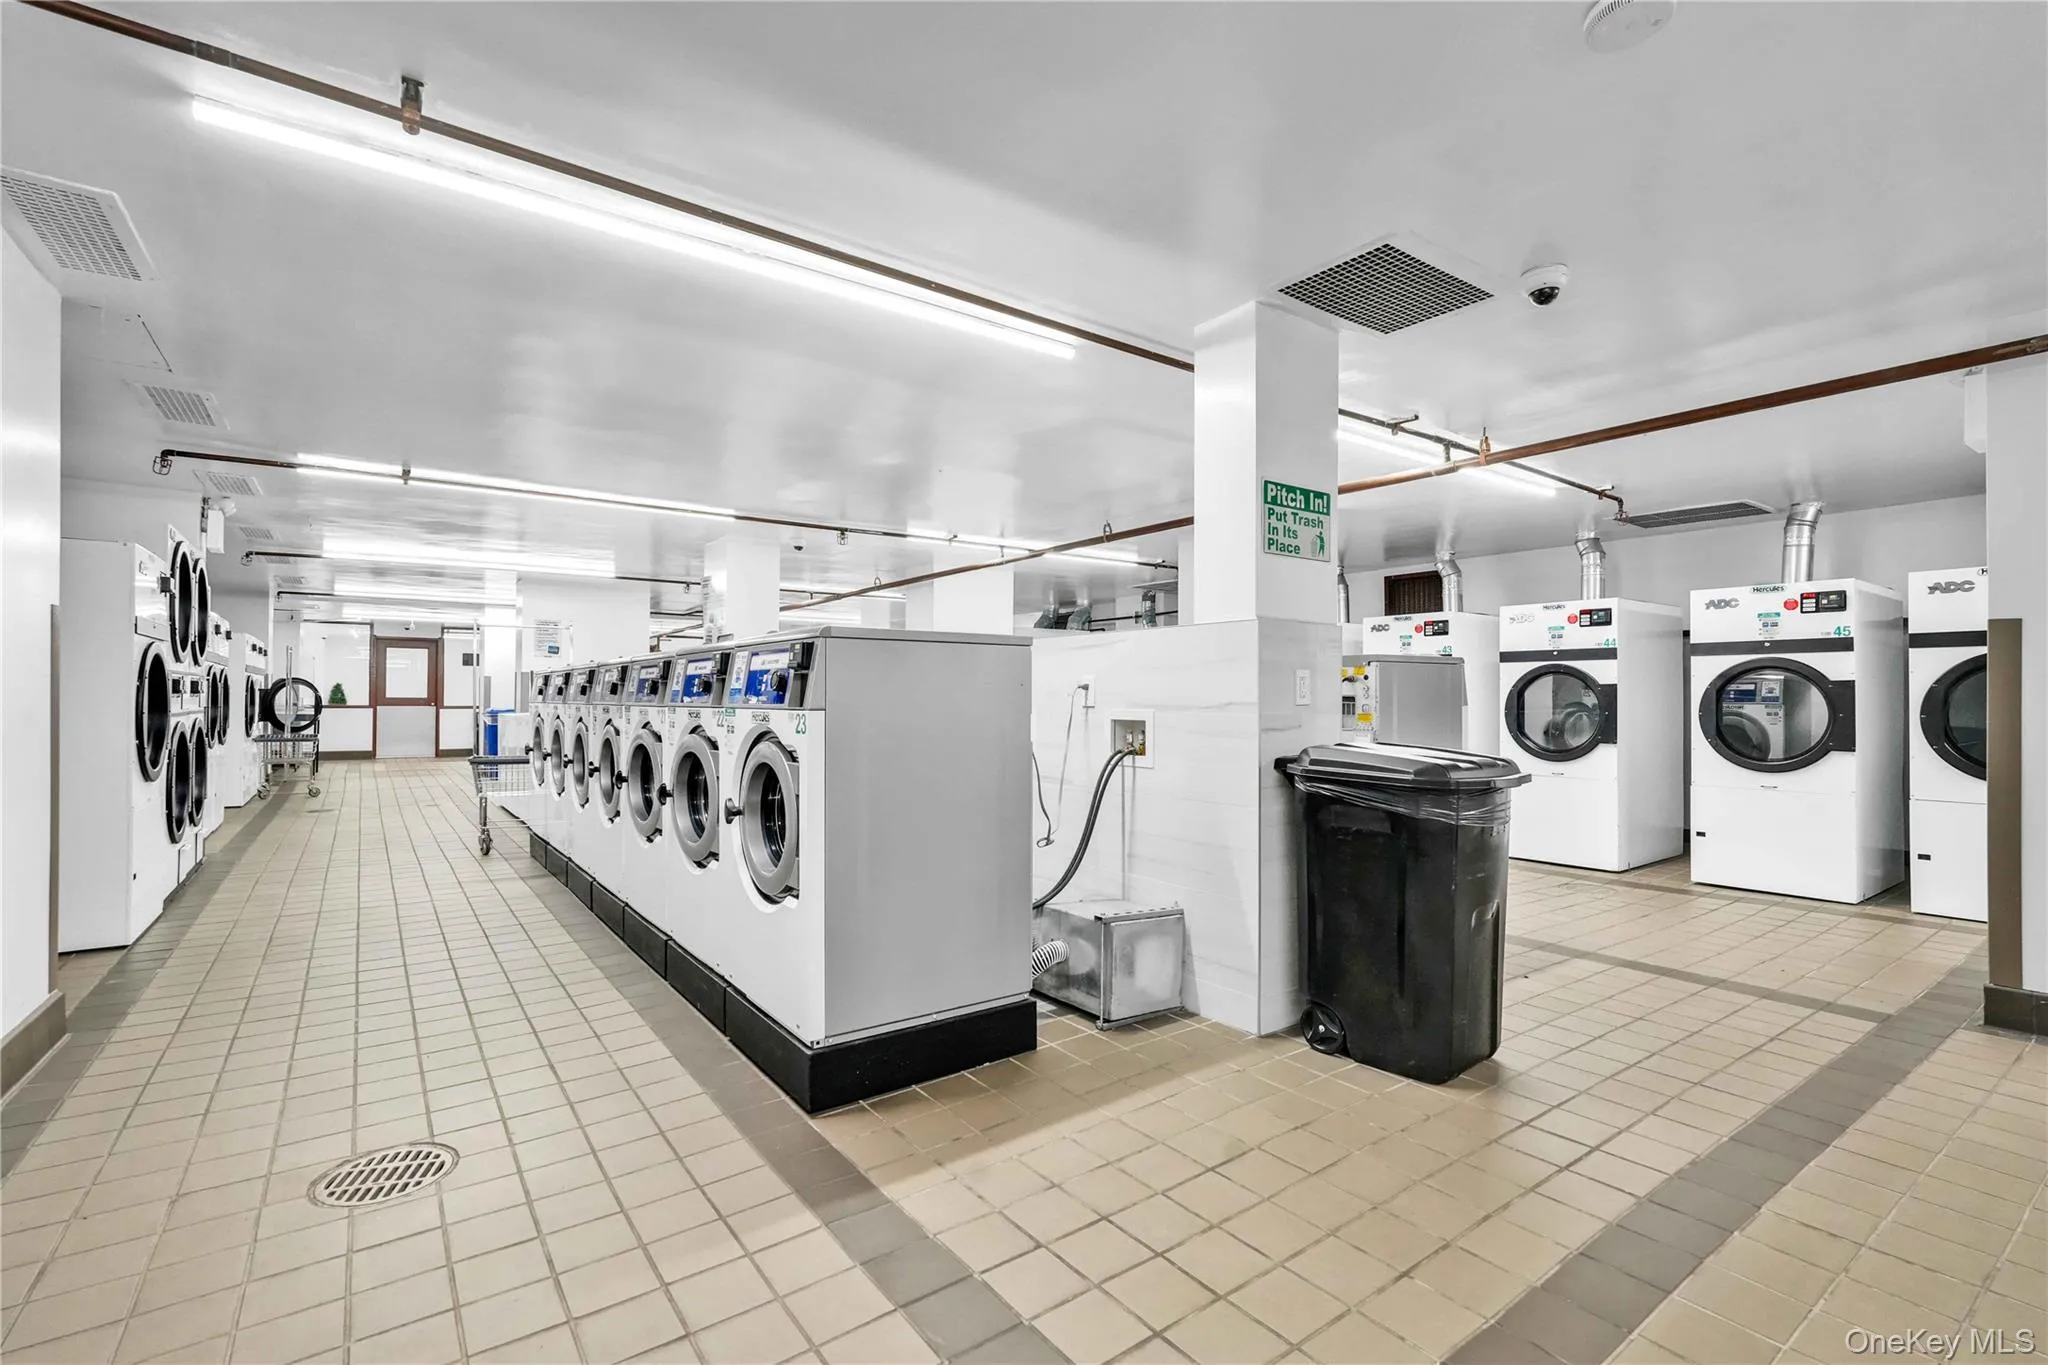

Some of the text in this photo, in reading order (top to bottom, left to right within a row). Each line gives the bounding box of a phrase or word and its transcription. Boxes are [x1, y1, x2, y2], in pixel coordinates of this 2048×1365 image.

[1267, 483, 1328, 514] Pitch In!
[1267, 507, 1324, 529] Put Trash
[1268, 522, 1298, 539] In Its
[1267, 538, 1301, 554] Place
[1752, 585, 1785, 593] Hercules
[1927, 580, 1976, 595] ADC
[1704, 597, 1741, 610] ADC
[1370, 623, 1391, 633] ADC
[1833, 625, 1852, 637] 45
[1441, 645, 1453, 654] 43
[1603, 637, 1617, 648] 44
[795, 713, 807, 735] 23
